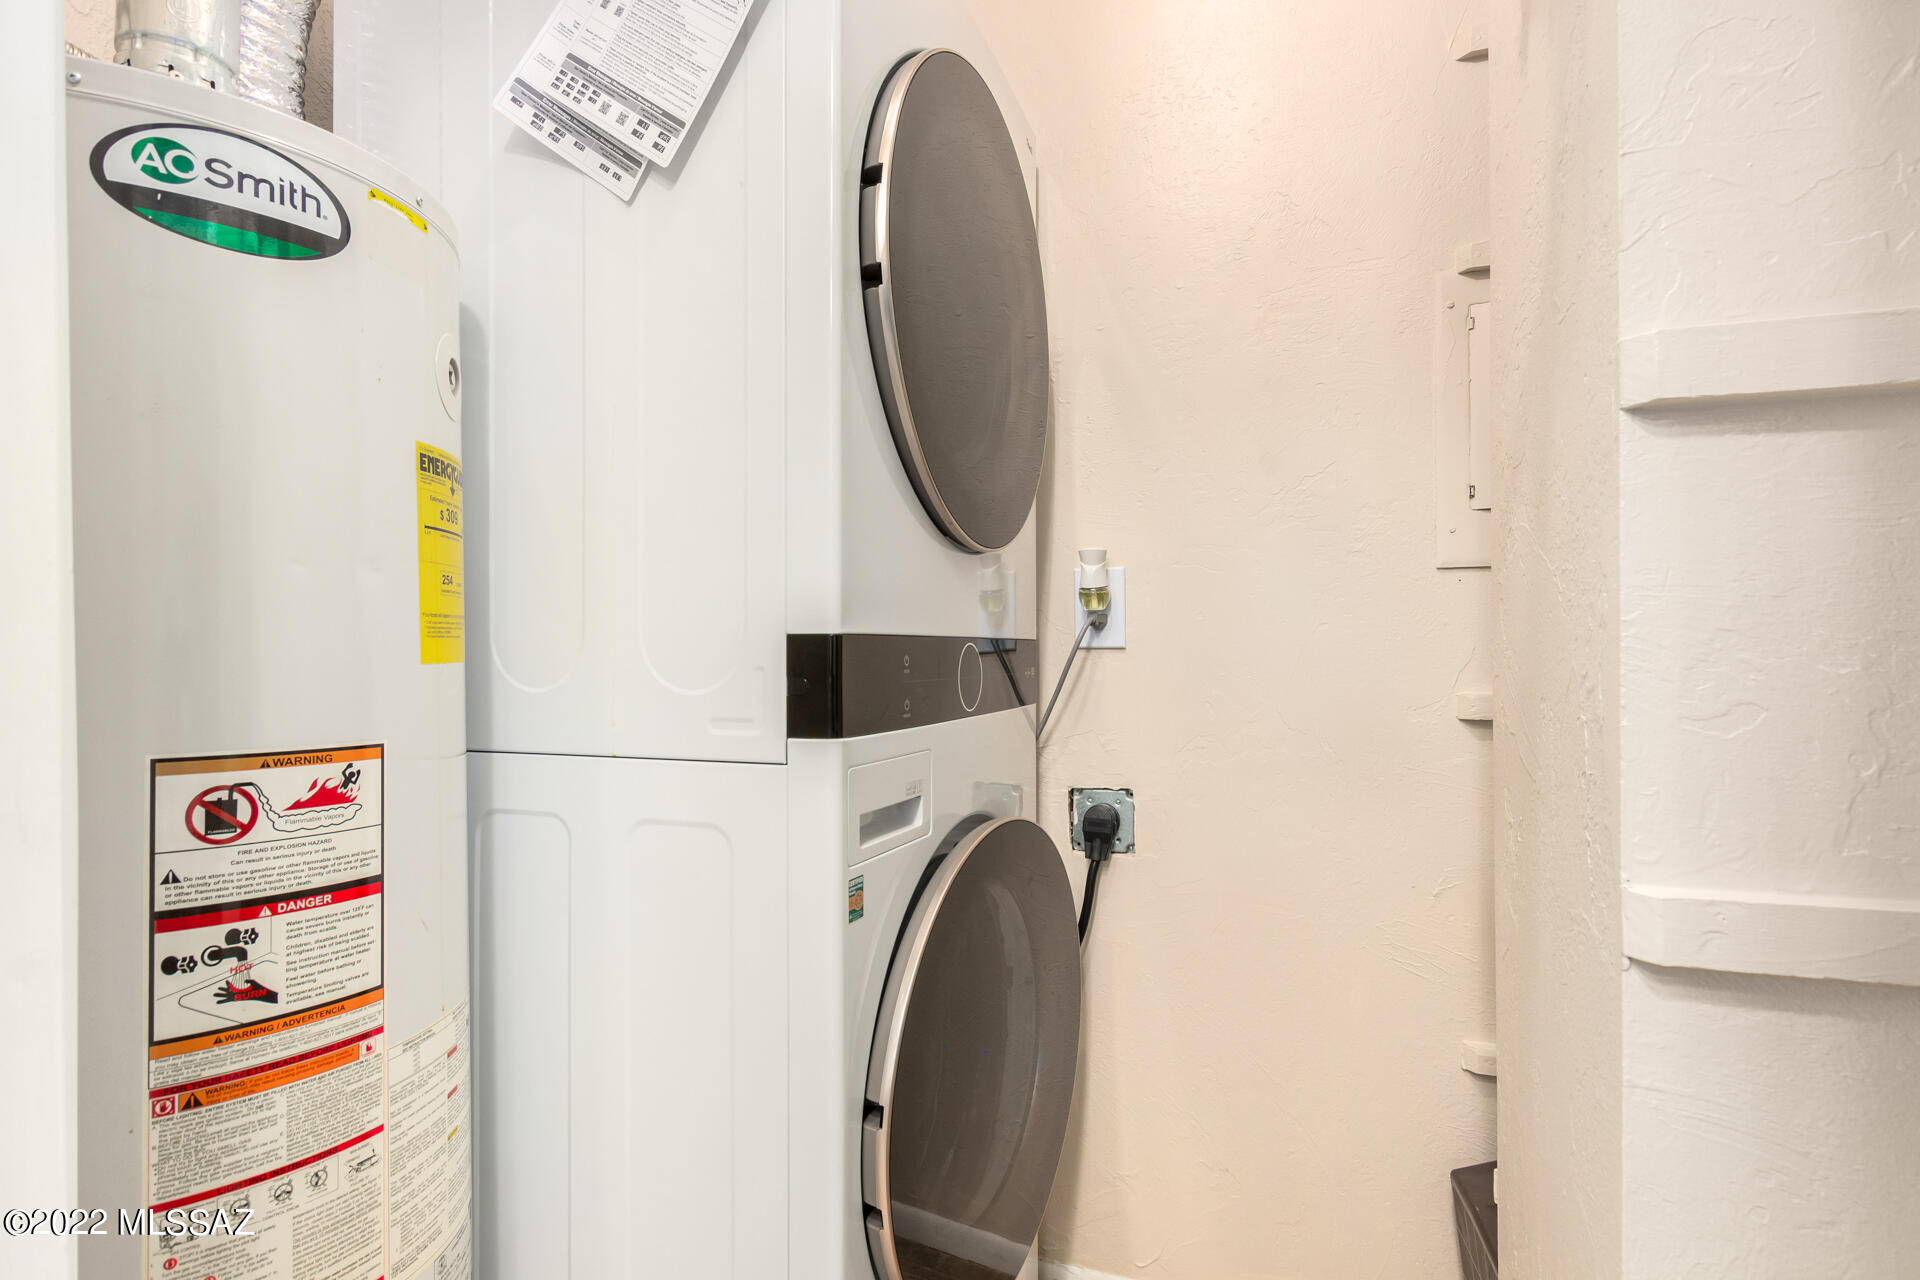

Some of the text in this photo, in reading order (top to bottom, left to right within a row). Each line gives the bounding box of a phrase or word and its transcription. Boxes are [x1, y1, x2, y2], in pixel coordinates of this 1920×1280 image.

[442, 574, 453, 585] 254
[273, 754, 333, 767] WARNING
[285, 816, 322, 825] Flammable
[270, 842, 307, 851] EXPLOSION
[250, 866, 276, 876] gasoline
[194, 886, 229, 895] flammable
[164, 897, 198, 906] appliance
[278, 894, 333, 913] DANGER
[305, 913, 338, 923] temperature
[342, 913, 363, 921] instantly
[314, 936, 337, 944] disabled
[293, 947, 315, 956] highest
[298, 952, 329, 962] instruction
[230, 962, 253, 974] HOT
[299, 958, 333, 970] temperature
[336, 961, 355, 970] bathing
[234, 988, 267, 1001] BURN
[286, 985, 322, 998] Temperature
[224, 1004, 346, 1042] WARNING ADVERTENCIA
[164, 1084, 186, 1095] FOR
[191, 1076, 221, 1089] YOUR
[226, 1066, 265, 1081] SAFETY
[268, 1056, 296, 1070] READ
[298, 1045, 334, 1062] BEFORE
[218, 1147, 338, 1195] LIGHTING INSTRUCTIONS
